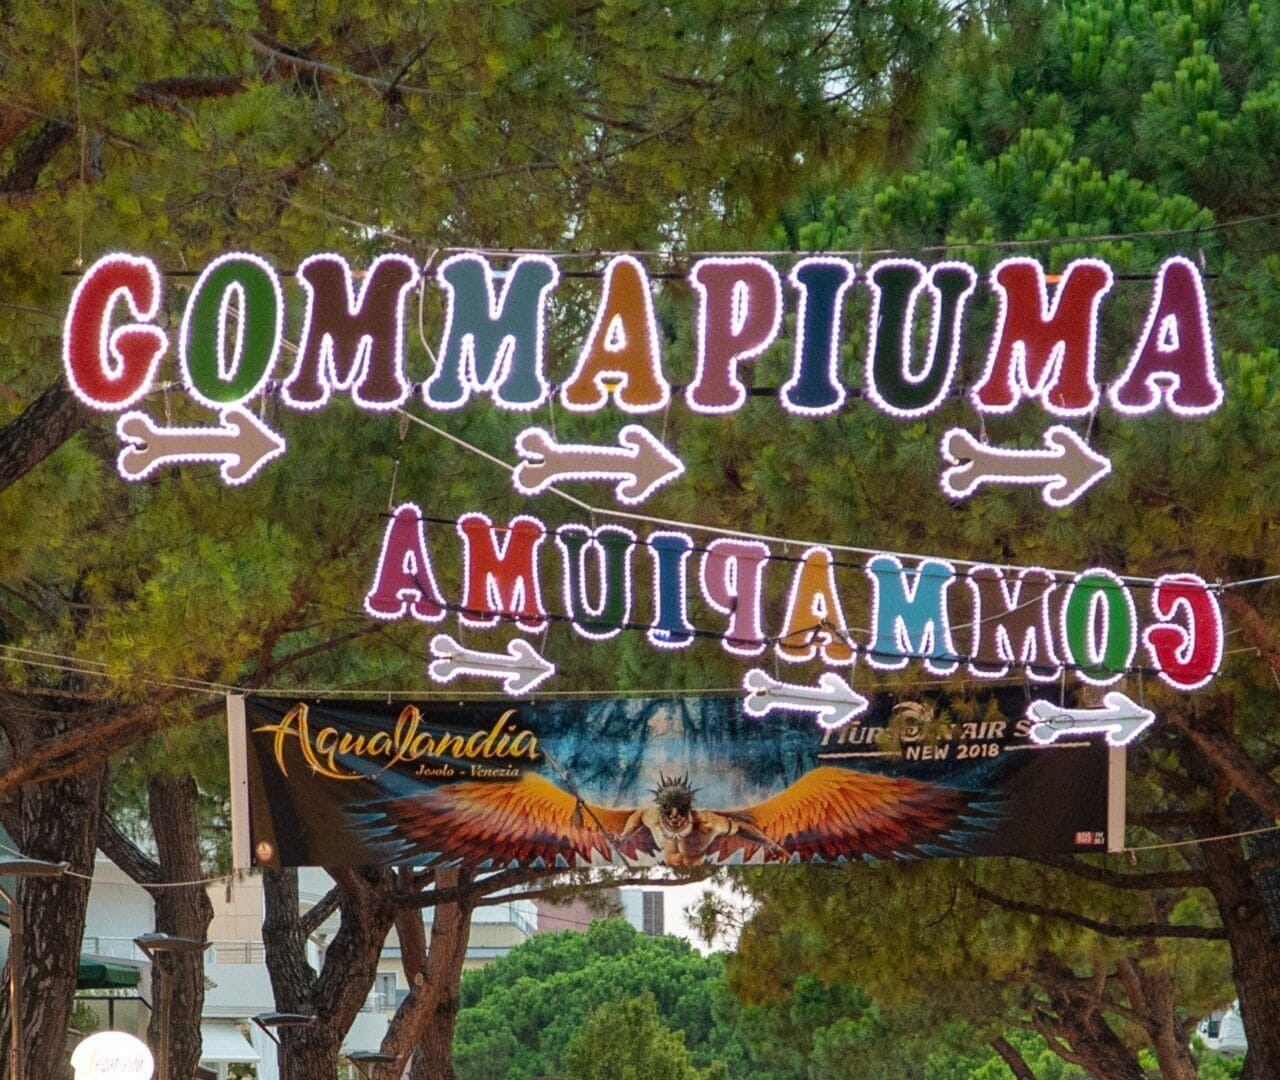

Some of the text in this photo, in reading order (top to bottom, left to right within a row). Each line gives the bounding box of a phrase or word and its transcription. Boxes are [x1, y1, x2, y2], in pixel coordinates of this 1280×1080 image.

[62, 251, 1226, 417] GOMMAPIUMA
[252, 702, 540, 780] Aqualandia
[906, 743, 1000, 761] NEW 2018
[416, 765, 454, 777] Jesolo
[470, 765, 519, 777] Venezia
